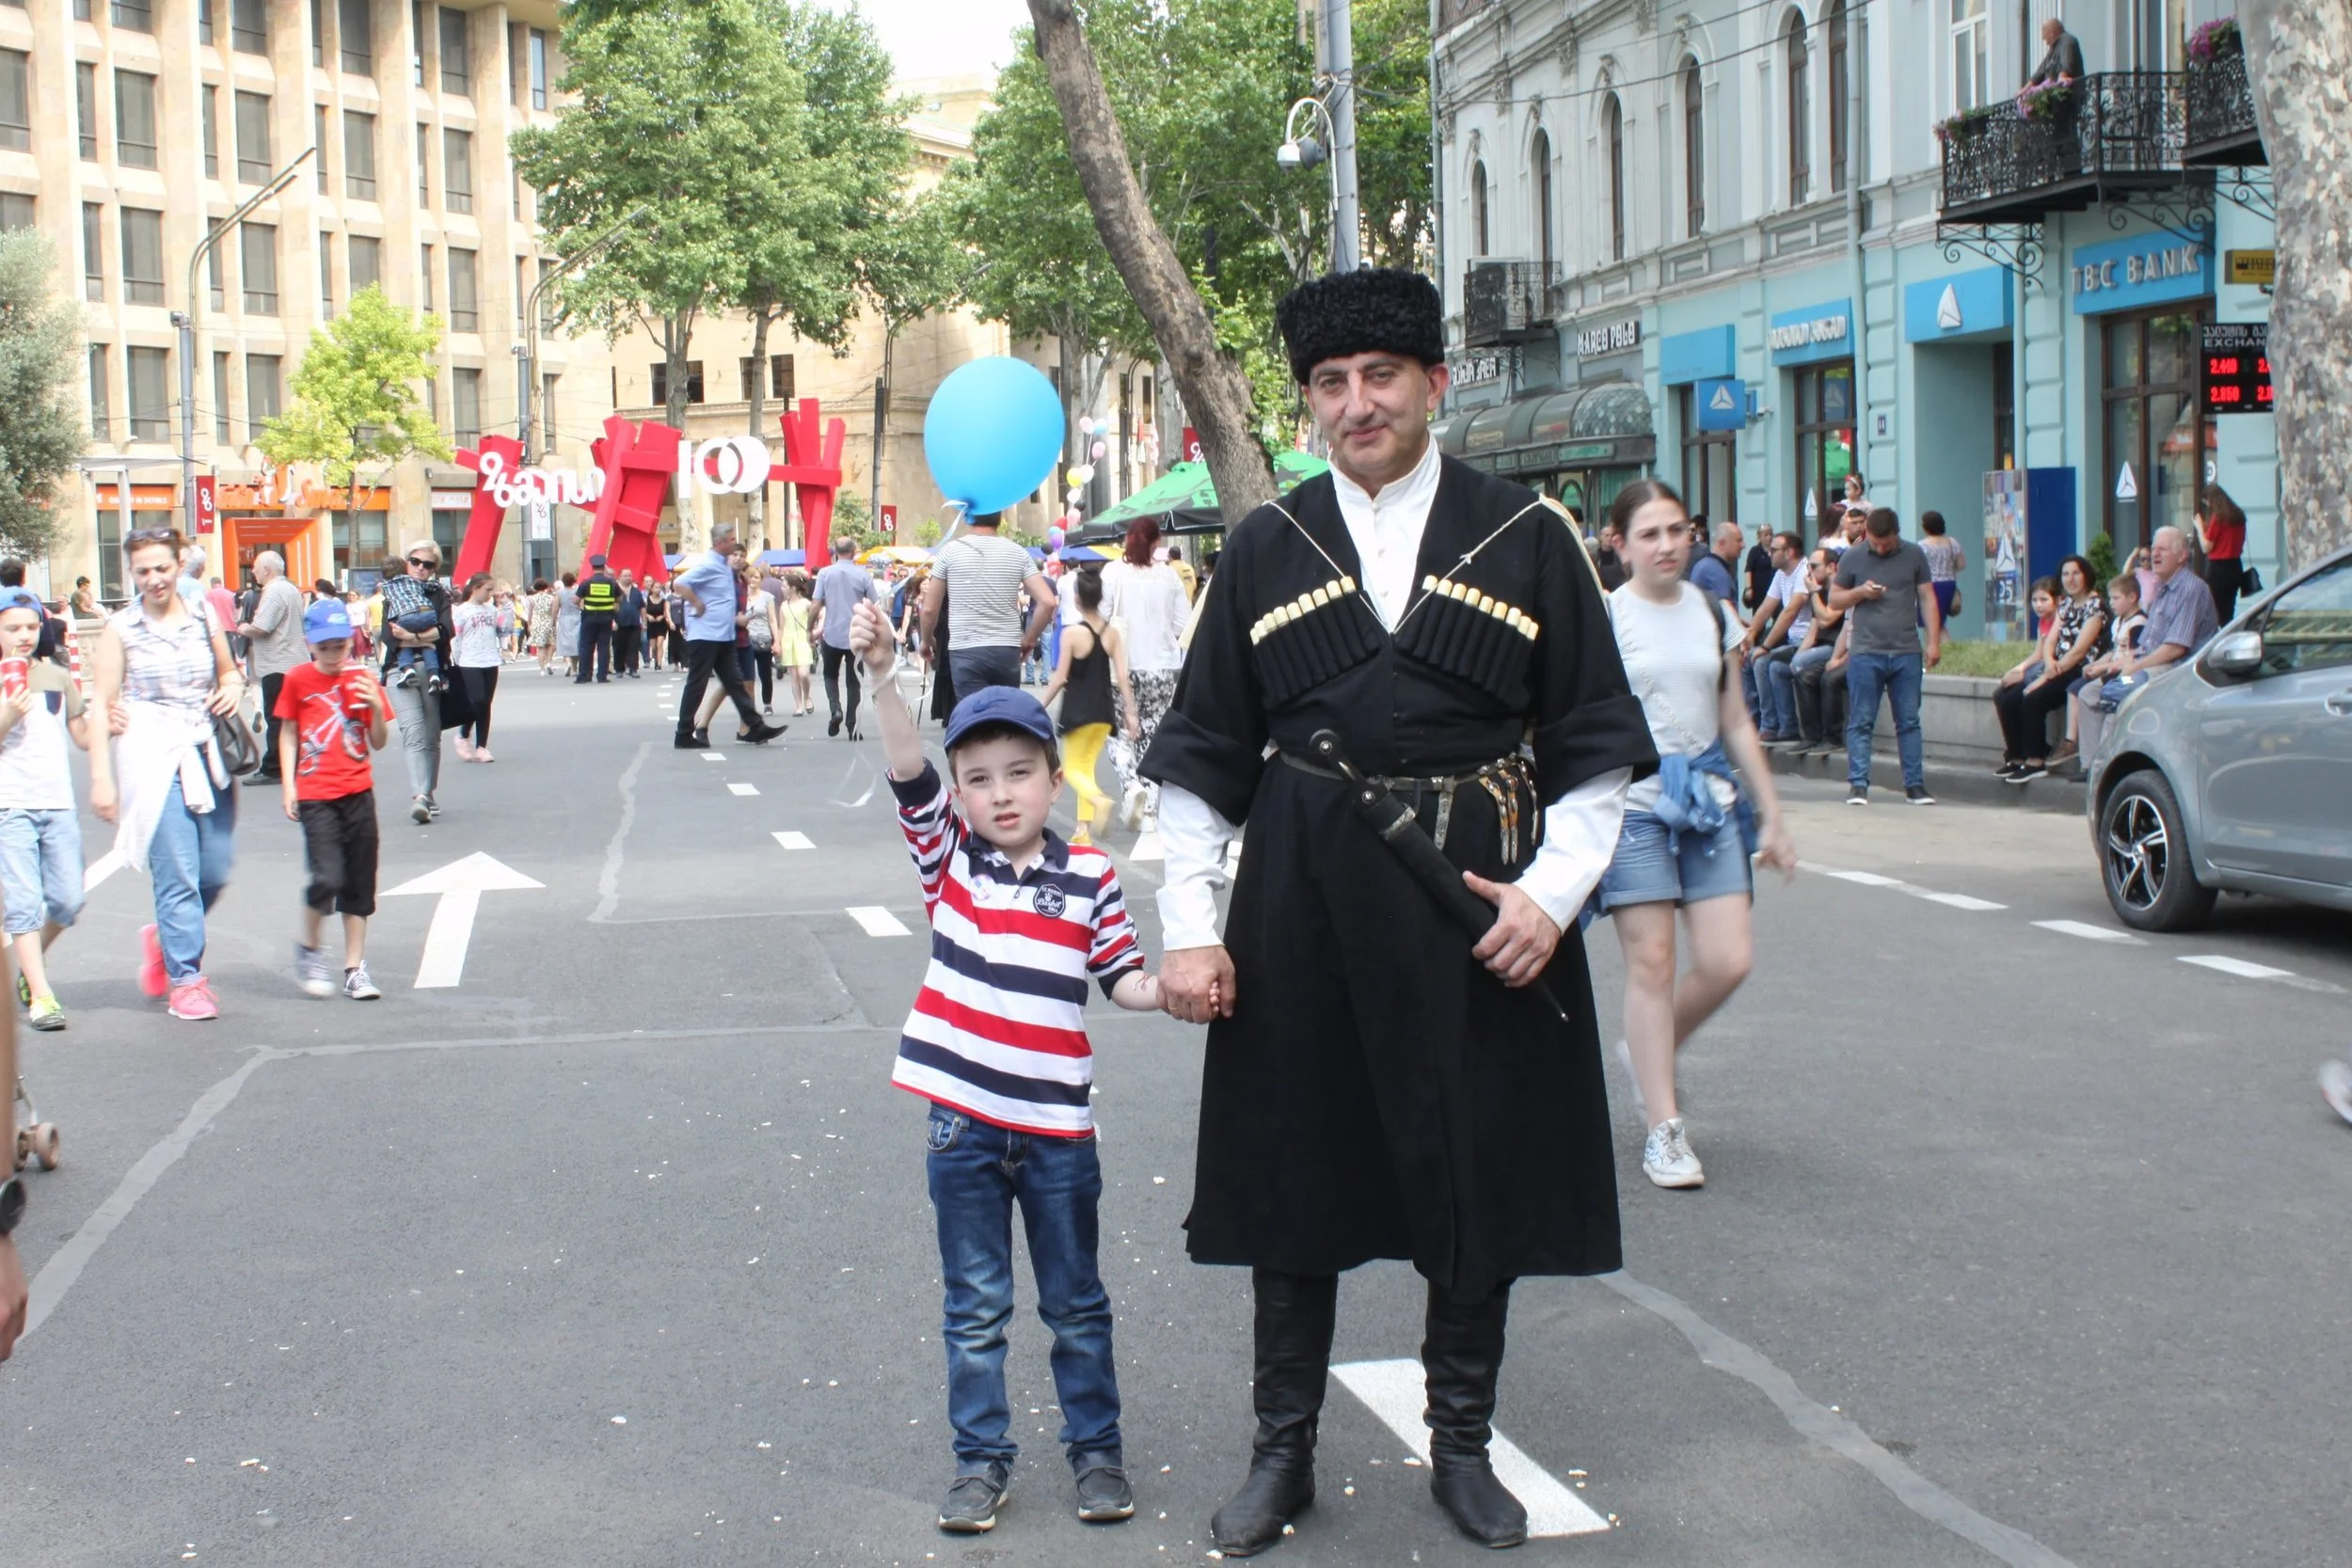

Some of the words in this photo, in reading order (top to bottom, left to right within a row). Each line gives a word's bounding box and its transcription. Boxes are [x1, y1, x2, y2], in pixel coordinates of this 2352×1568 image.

[2072, 260, 2118, 294] TBC
[2127, 243, 2201, 285] BANK
[1578, 328, 1608, 356] MARCO
[1610, 321, 1635, 349] POLO
[2204, 338, 2265, 347] EXCHAN
